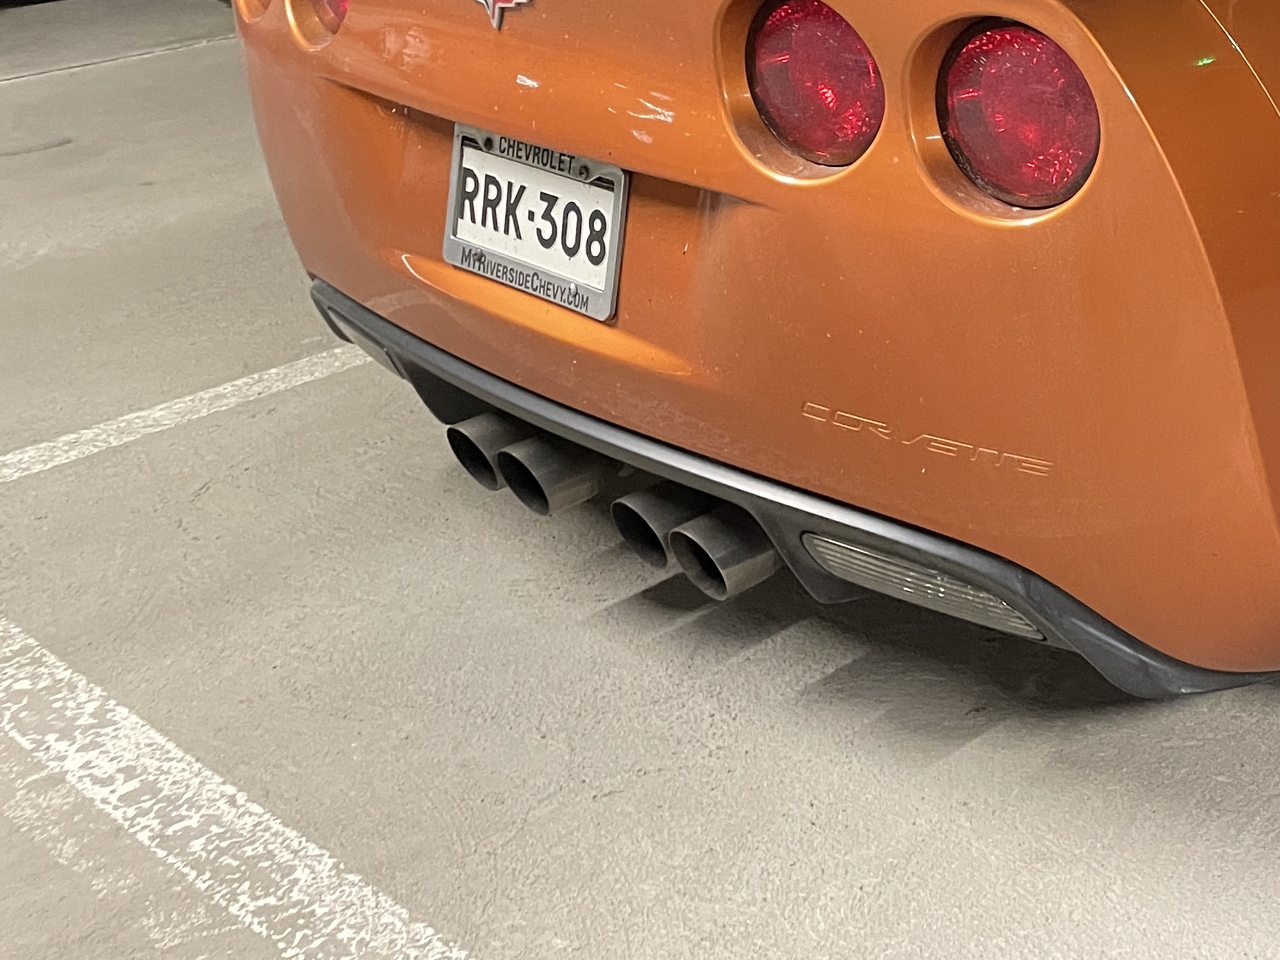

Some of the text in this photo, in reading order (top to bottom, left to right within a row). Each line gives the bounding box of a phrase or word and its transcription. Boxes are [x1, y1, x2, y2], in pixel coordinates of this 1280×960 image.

[498, 136, 577, 175] CHEVROLET
[460, 166, 608, 267] RRK-308
[800, 401, 1055, 477] CORVETTE
